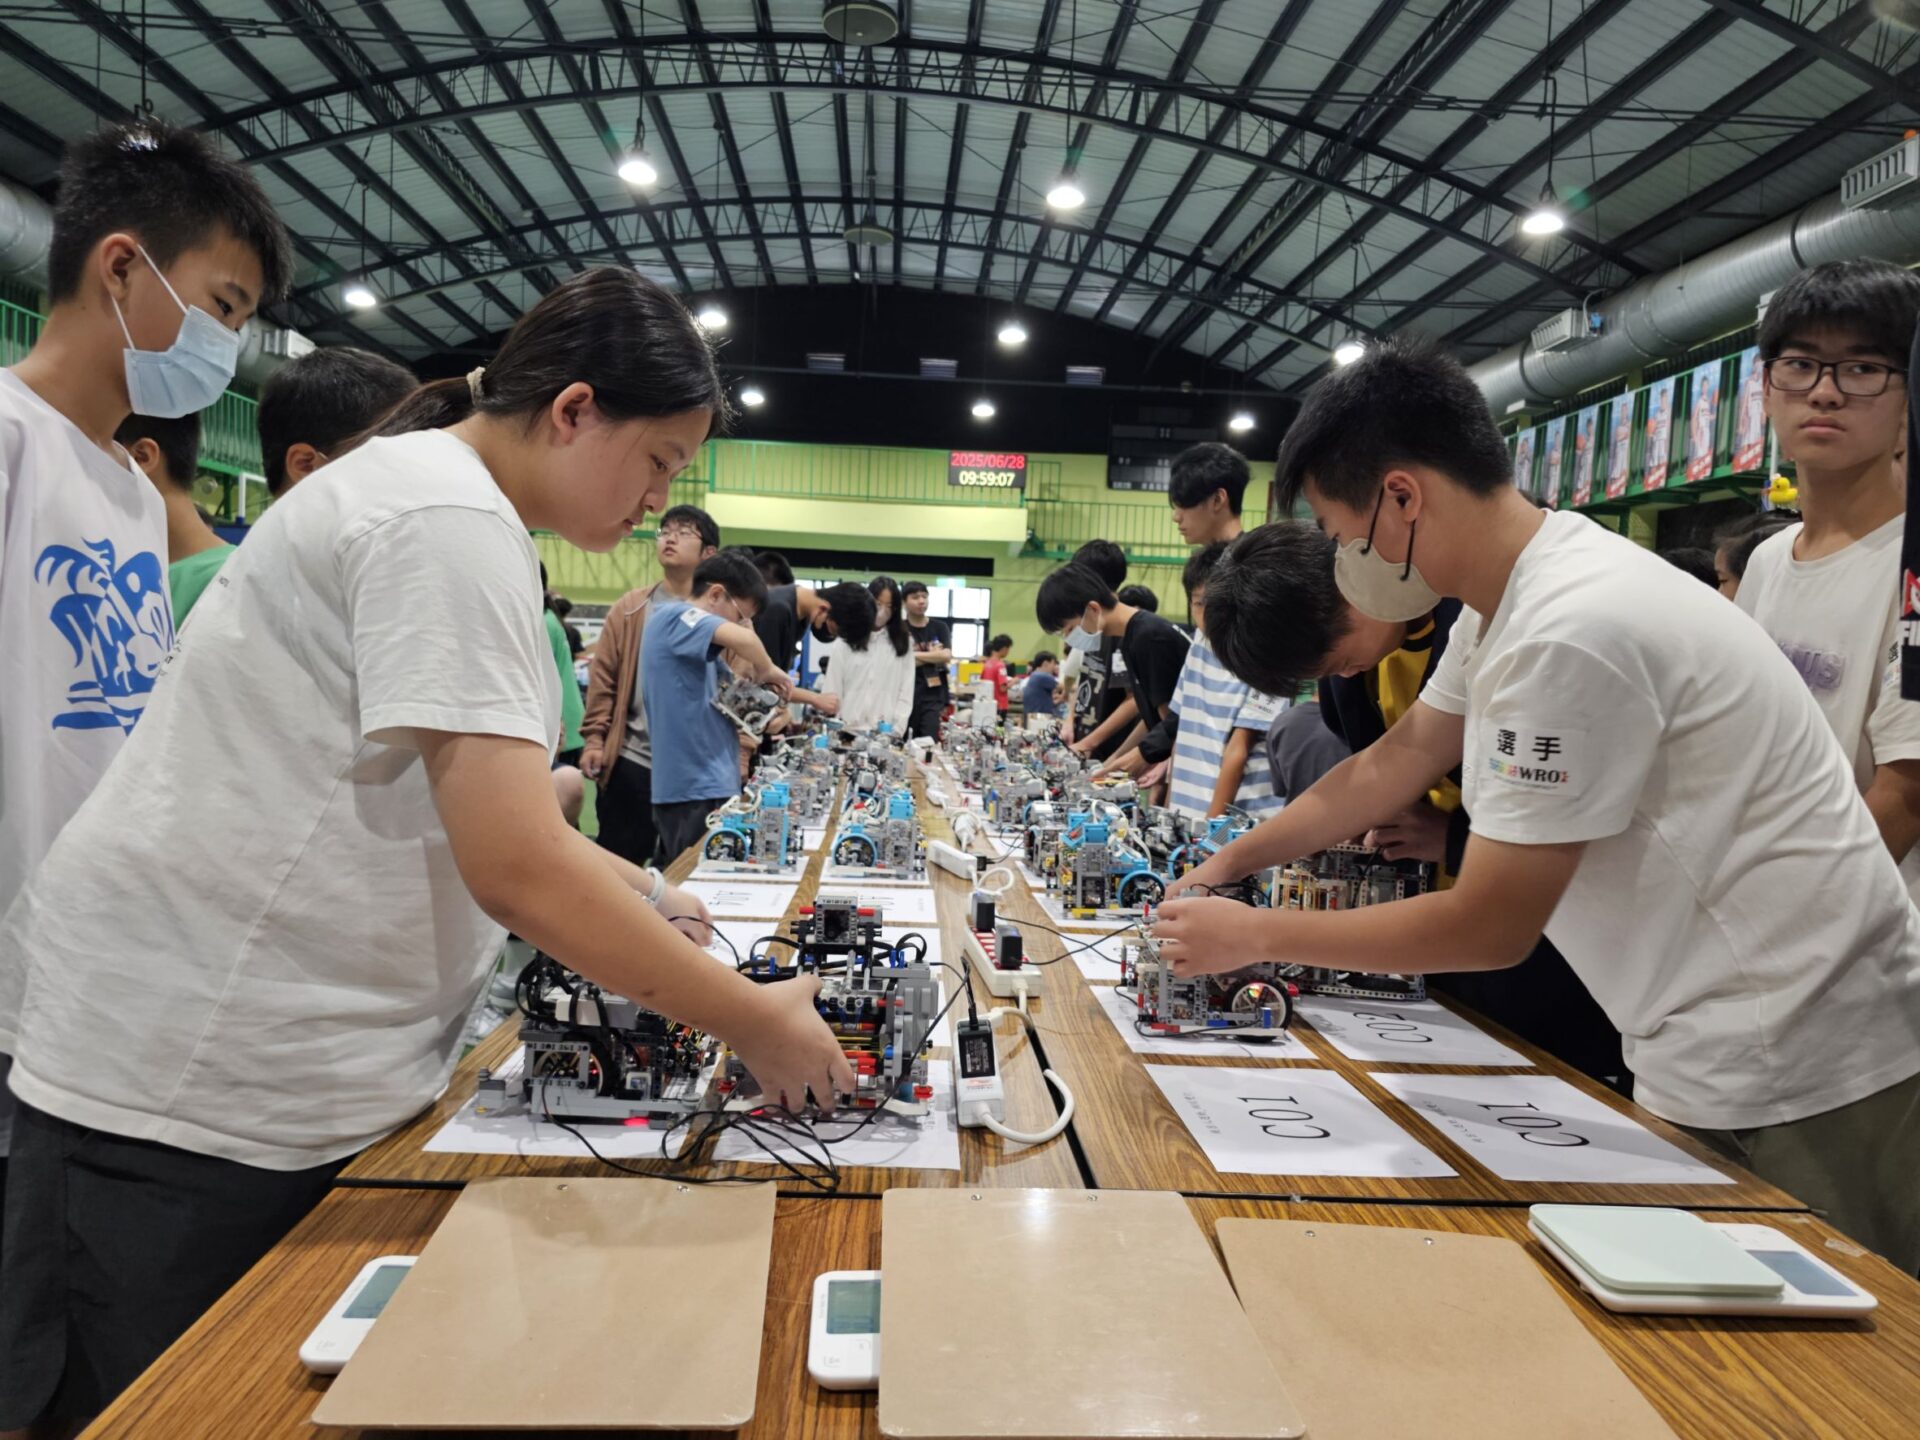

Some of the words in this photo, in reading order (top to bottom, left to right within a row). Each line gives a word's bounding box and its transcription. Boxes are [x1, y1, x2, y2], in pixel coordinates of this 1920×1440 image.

[951, 452, 1025, 469] 2025/06/28
[958, 470, 1016, 487] 09:59:07
[1497, 729, 1562, 761] 選手
[1353, 1012, 1434, 1043] C02
[1237, 1095, 1331, 1139] C01
[1477, 1102, 1590, 1147] C01
